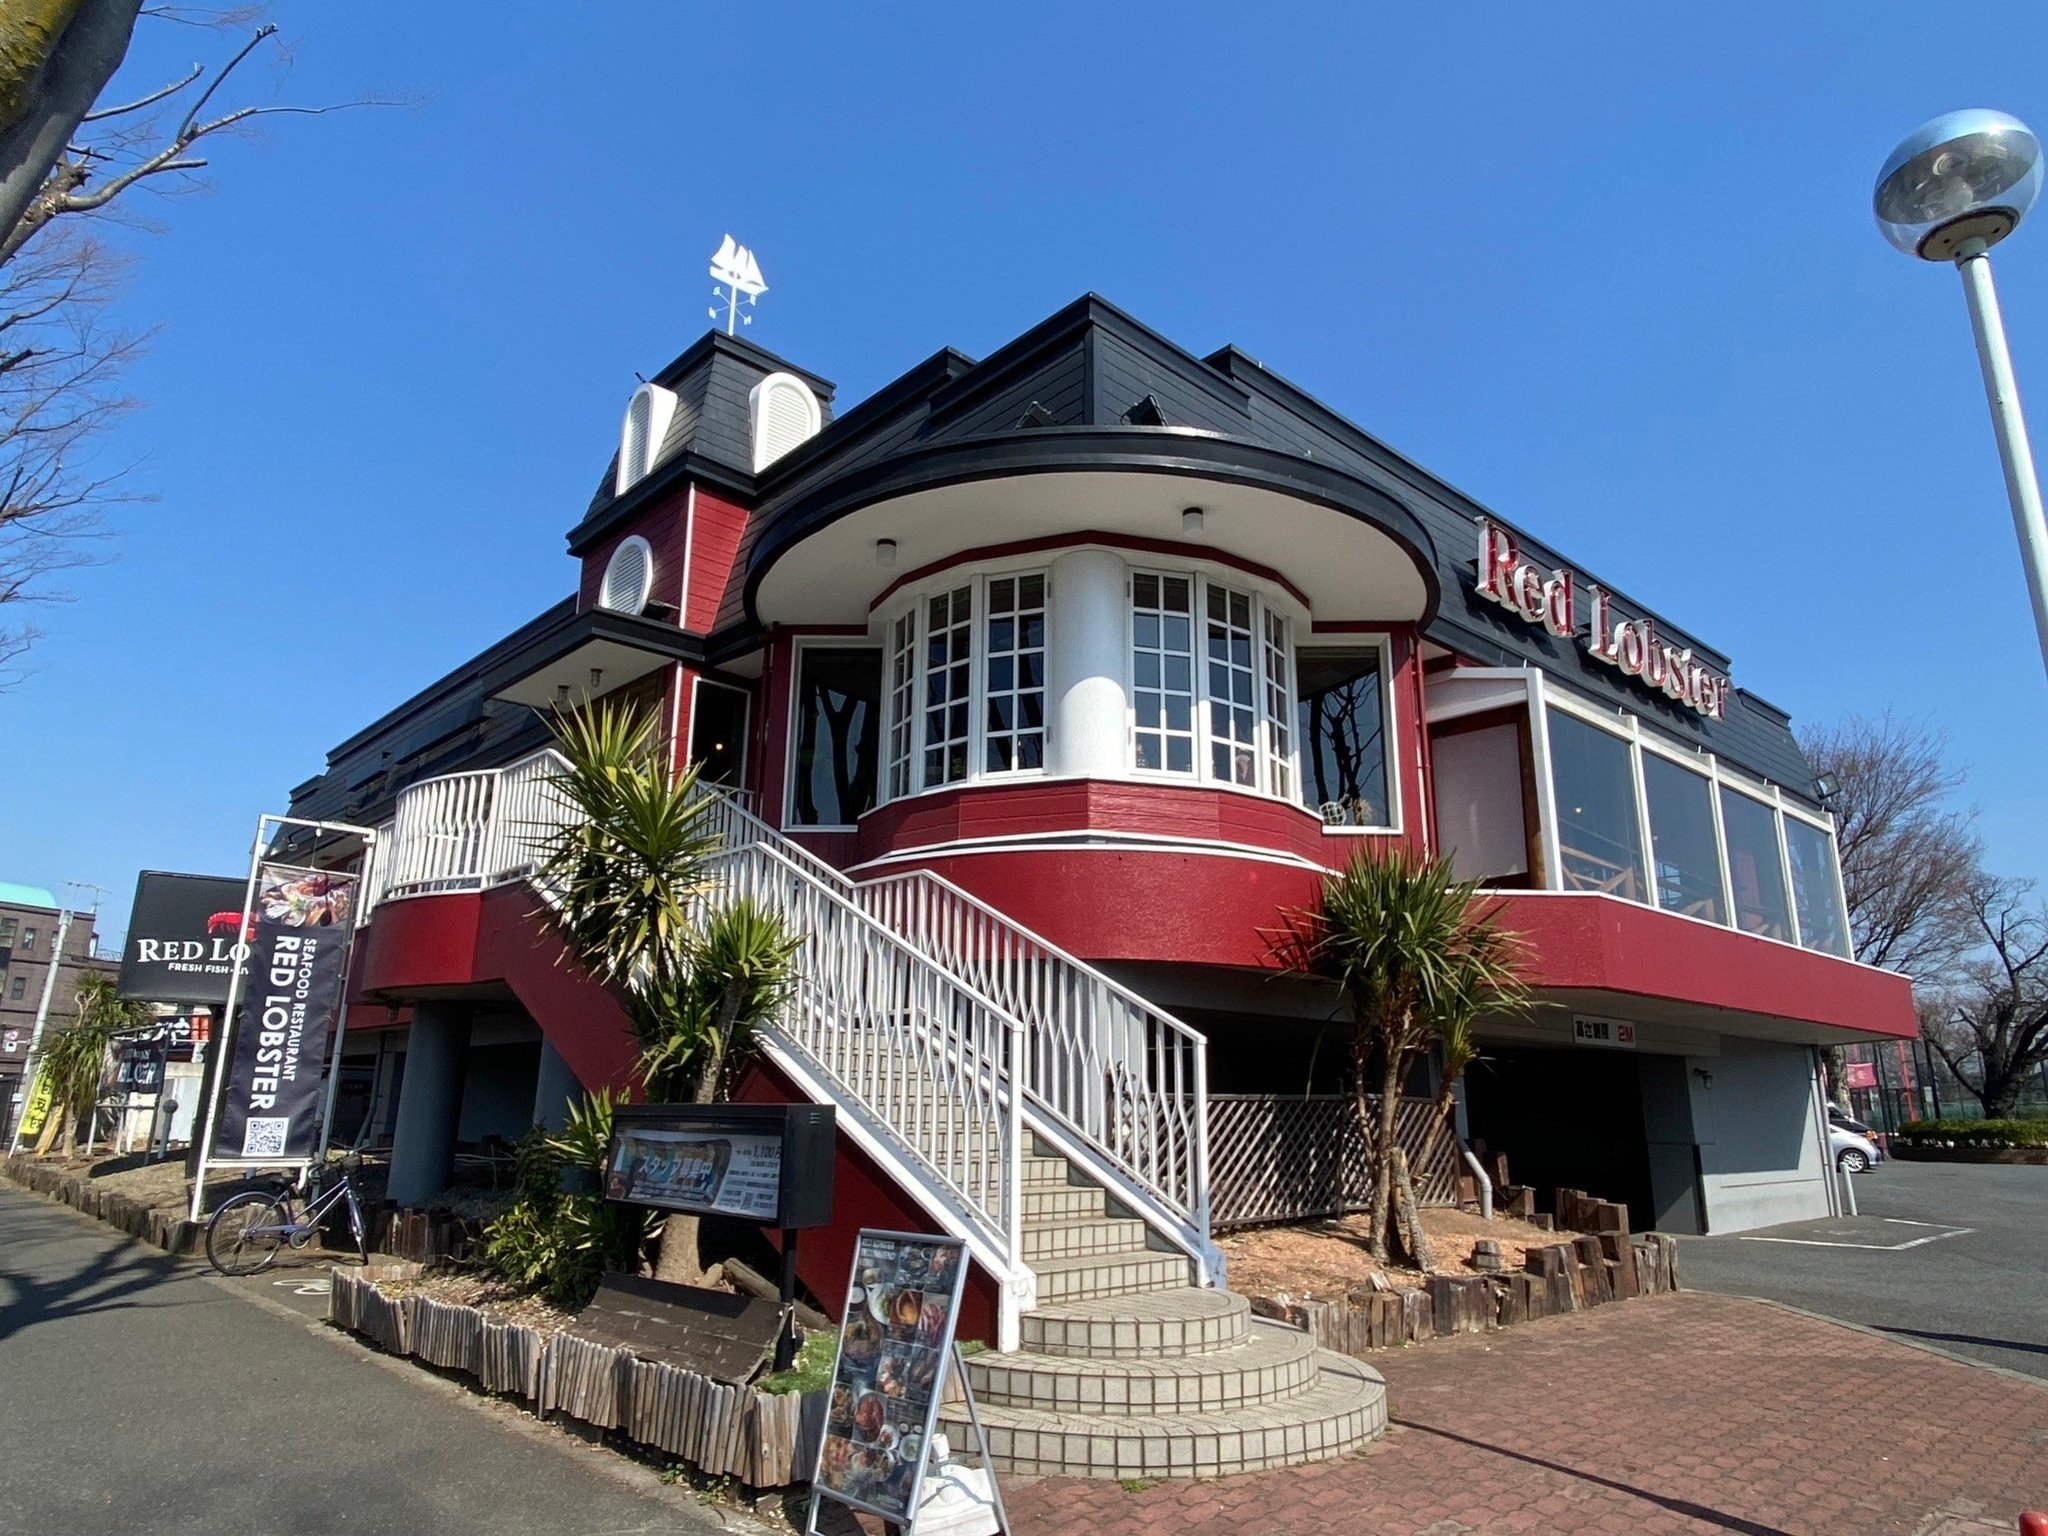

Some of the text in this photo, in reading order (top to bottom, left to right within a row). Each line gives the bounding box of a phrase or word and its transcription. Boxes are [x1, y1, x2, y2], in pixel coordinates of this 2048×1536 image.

[1474, 515, 1729, 722] Red Lobster
[137, 938, 204, 962] RED
[168, 962, 202, 973] FRESH
[249, 935, 301, 1109] RED LOBSTER
[282, 938, 317, 1082] SEAFOOD RESTAURANT
